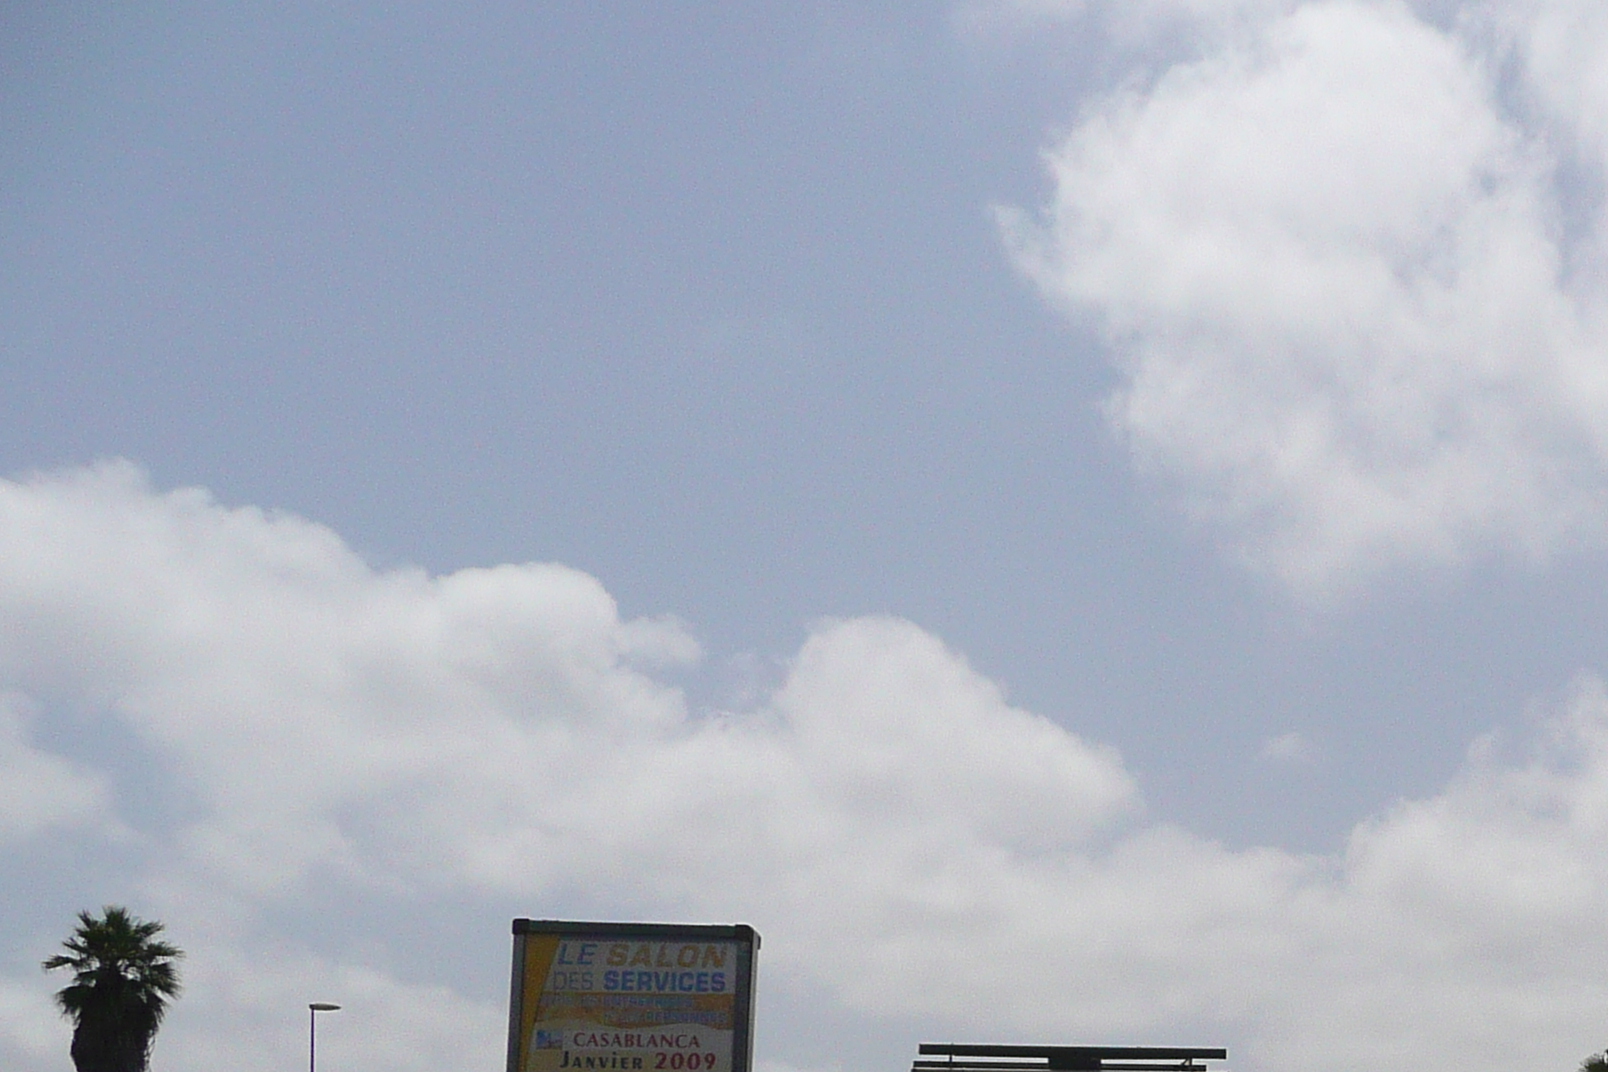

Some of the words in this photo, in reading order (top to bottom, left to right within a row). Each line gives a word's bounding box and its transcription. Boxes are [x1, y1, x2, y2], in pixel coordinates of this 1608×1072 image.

[558, 943, 598, 966] LE
[606, 942, 726, 967] SALON
[554, 971, 594, 990] DES
[604, 970, 726, 992] SERVICES
[573, 1032, 701, 1049] CASABLANCA
[655, 1052, 716, 1070] 2009
